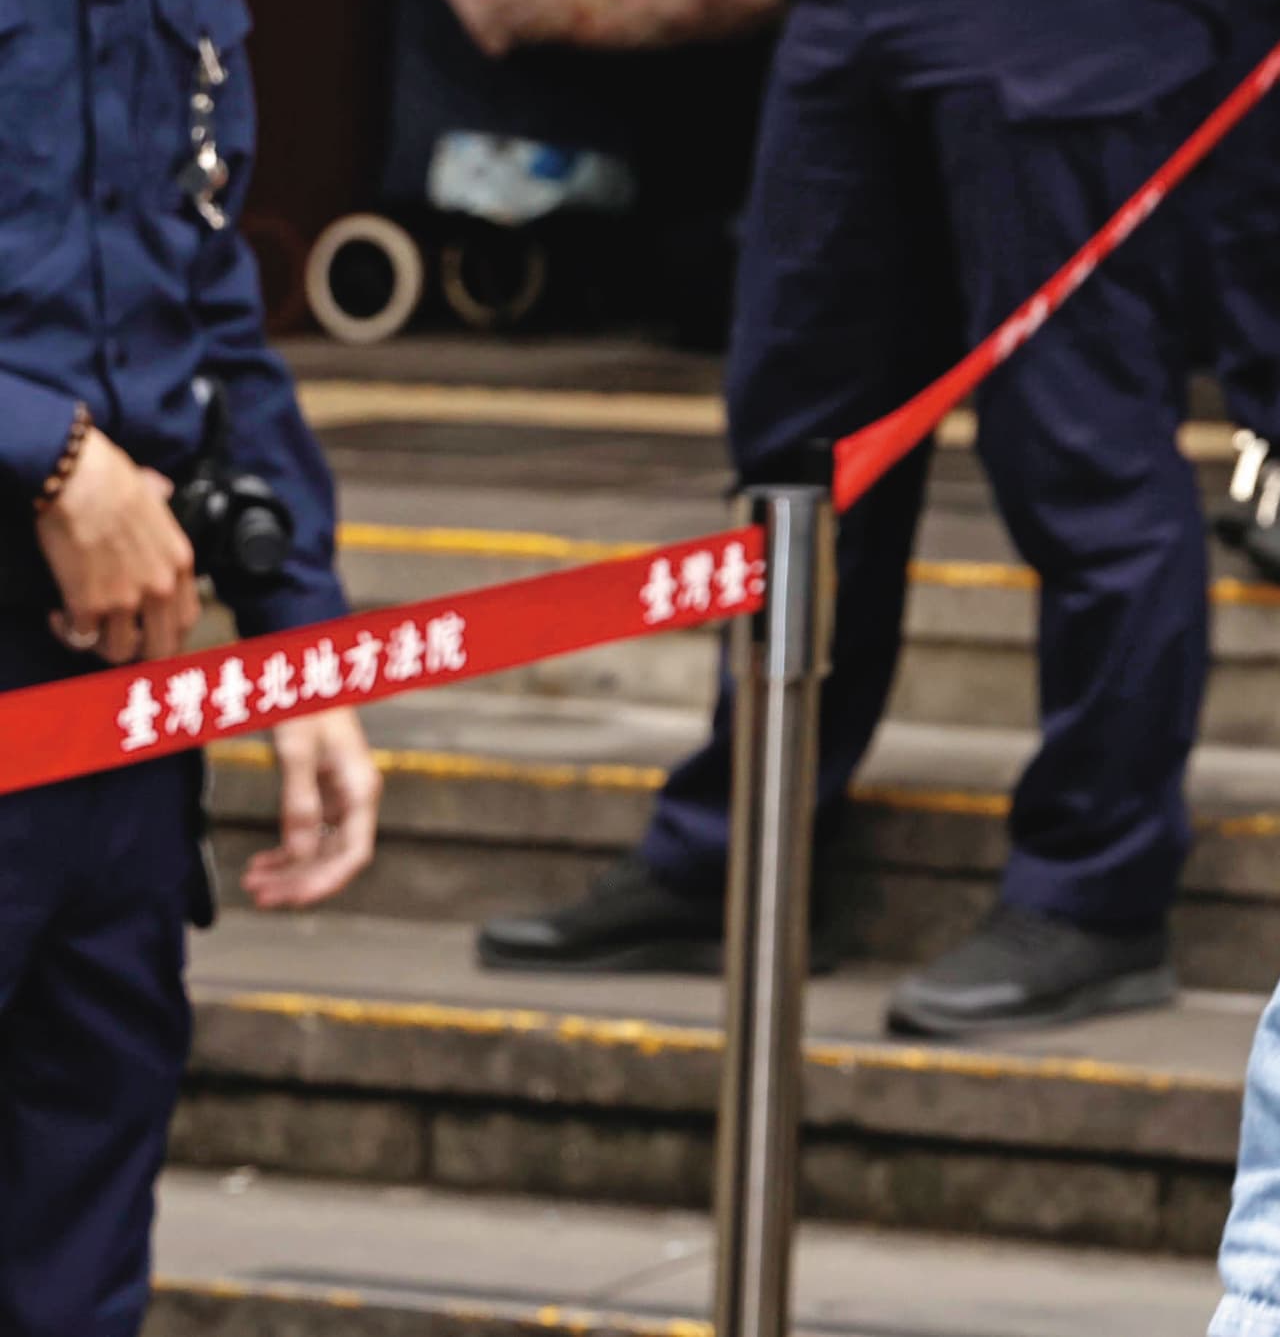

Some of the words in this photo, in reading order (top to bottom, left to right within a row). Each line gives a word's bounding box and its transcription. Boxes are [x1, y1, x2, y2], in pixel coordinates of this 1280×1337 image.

[118, 610, 467, 751] 臺灣臺北地方法院
